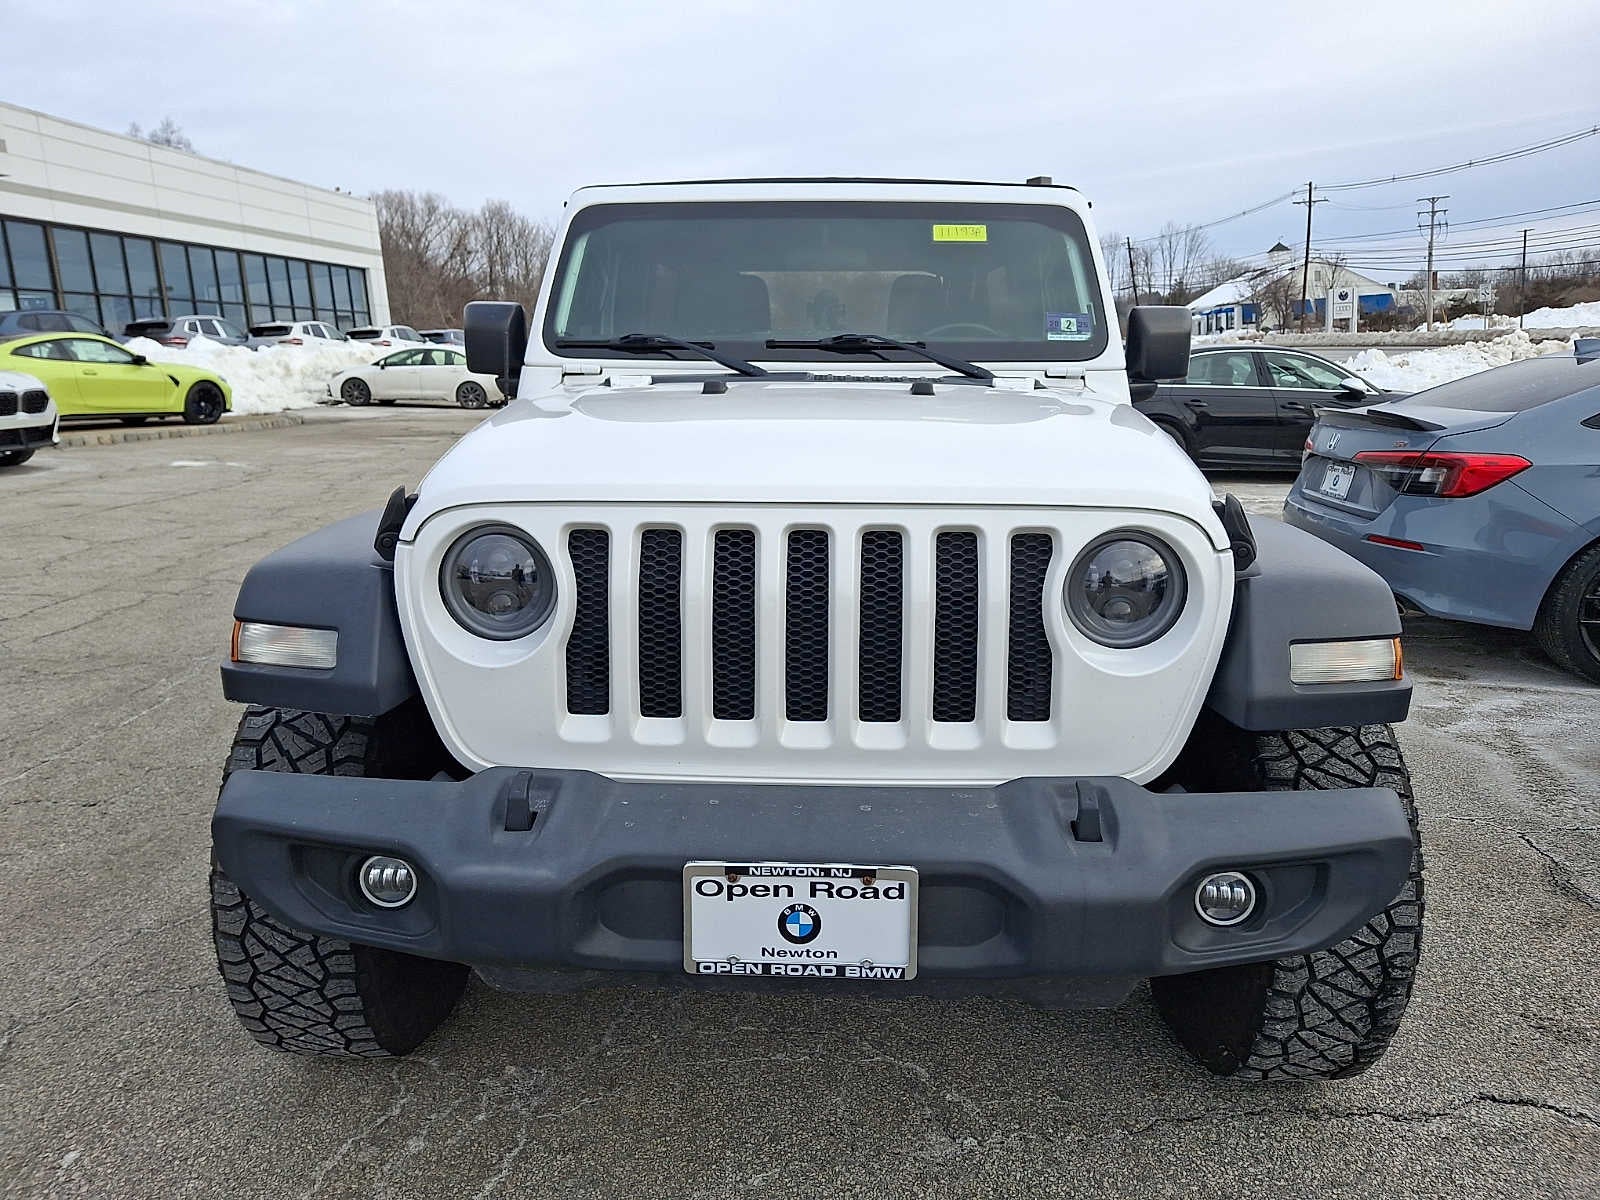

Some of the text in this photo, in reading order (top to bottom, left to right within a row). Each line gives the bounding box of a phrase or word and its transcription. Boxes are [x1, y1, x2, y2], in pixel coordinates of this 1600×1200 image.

[1065, 319, 1072, 330] 2
[830, 868, 852, 878] NJ
[695, 879, 905, 902] Open Road
[783, 904, 817, 917] BMW
[761, 947, 838, 959] Newton
[699, 962, 903, 979] OPEN ROAD BMW
